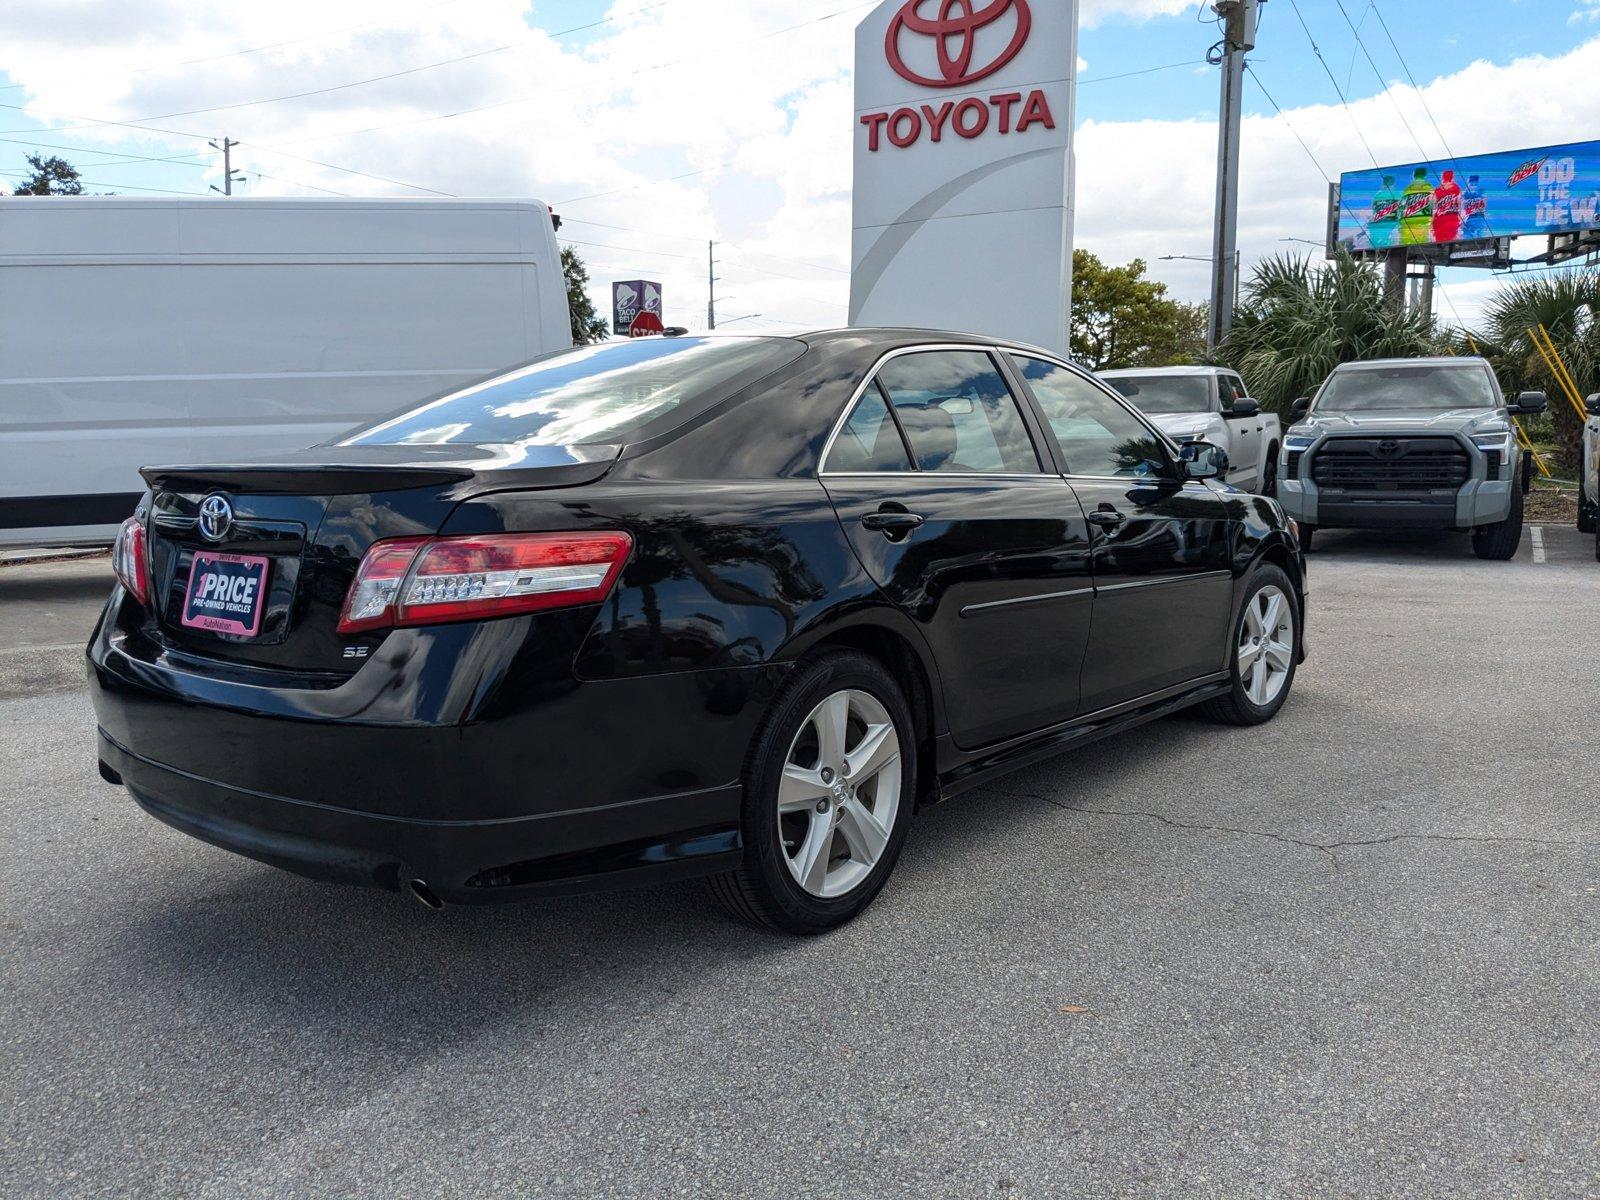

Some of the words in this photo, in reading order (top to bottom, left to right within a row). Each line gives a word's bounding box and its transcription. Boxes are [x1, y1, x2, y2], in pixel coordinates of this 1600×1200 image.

[860, 90, 1055, 152] TOYOTA
[1538, 157, 1575, 185] DO
[1538, 184, 1570, 202] THE
[1535, 197, 1598, 227] DEW
[193, 598, 225, 610] PRE-OWNED
[226, 602, 252, 614] VEHICLES
[203, 619, 232, 630] AutoNation
[343, 646, 369, 658] SE
